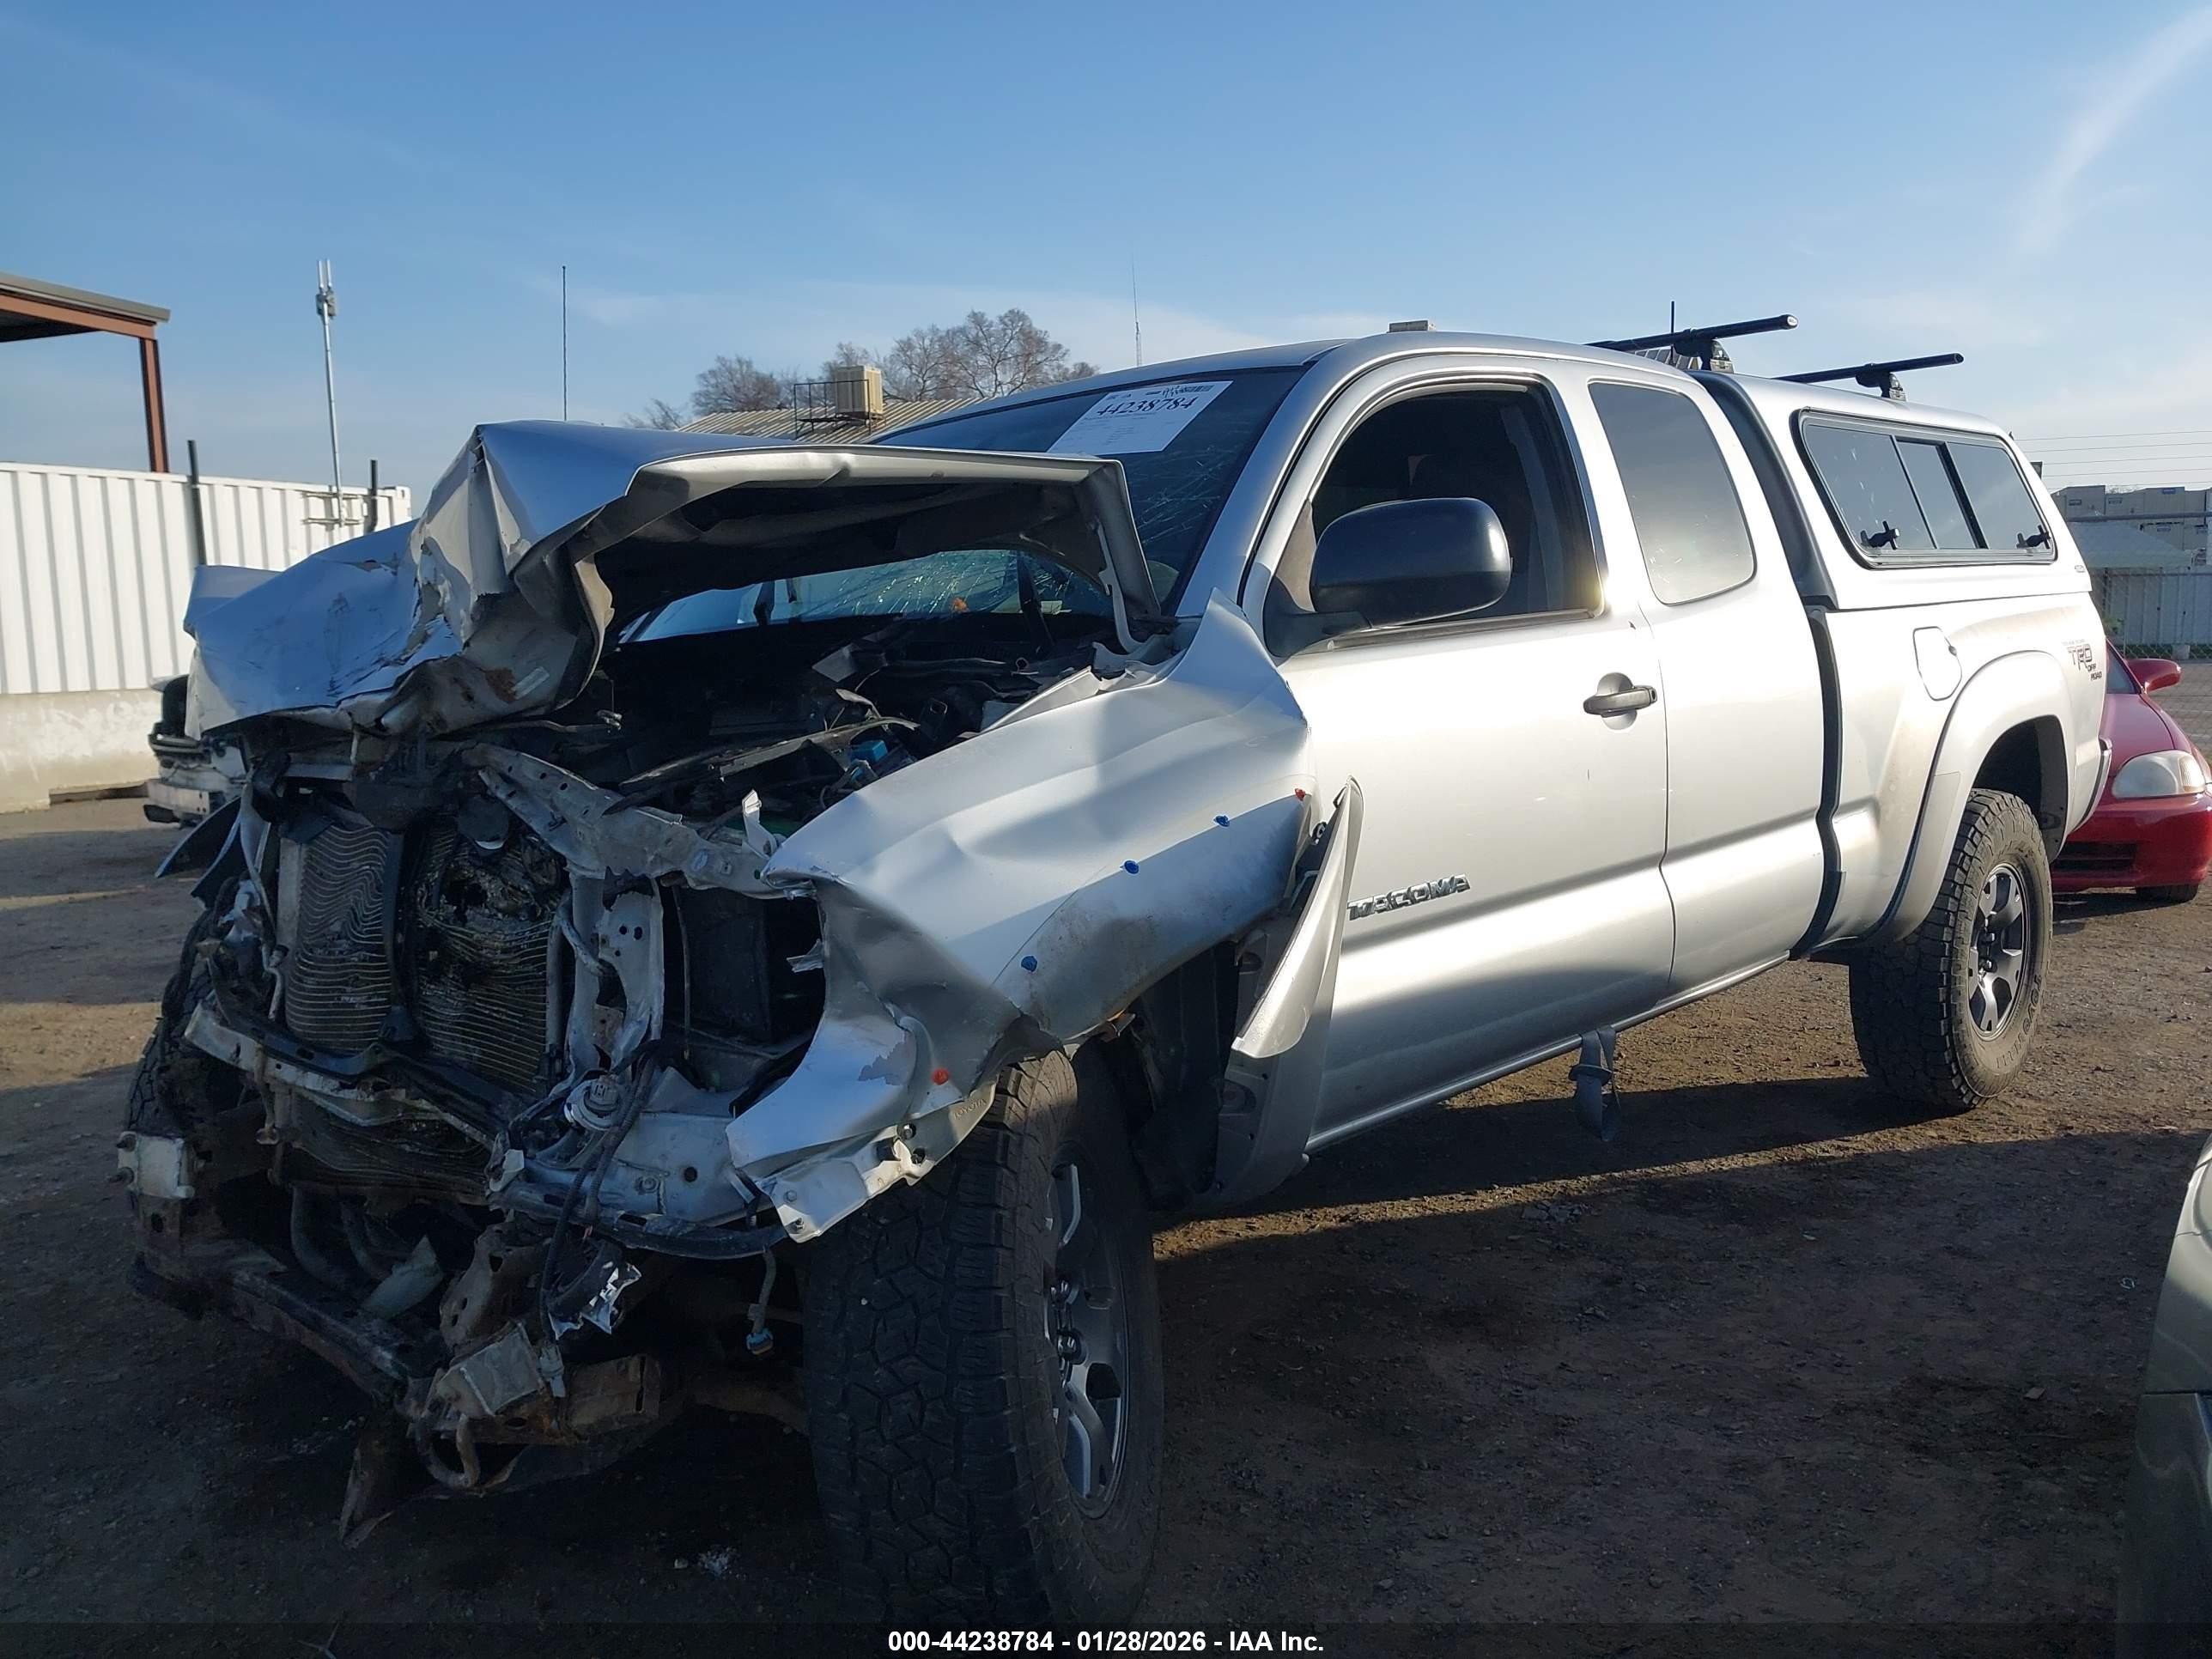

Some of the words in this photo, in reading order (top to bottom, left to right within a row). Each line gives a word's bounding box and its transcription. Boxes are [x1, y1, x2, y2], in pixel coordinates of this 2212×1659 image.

[1097, 396, 1199, 416] 44238784
[2067, 643, 2093, 671] TRD
[1346, 874, 1471, 921] TACOMA
